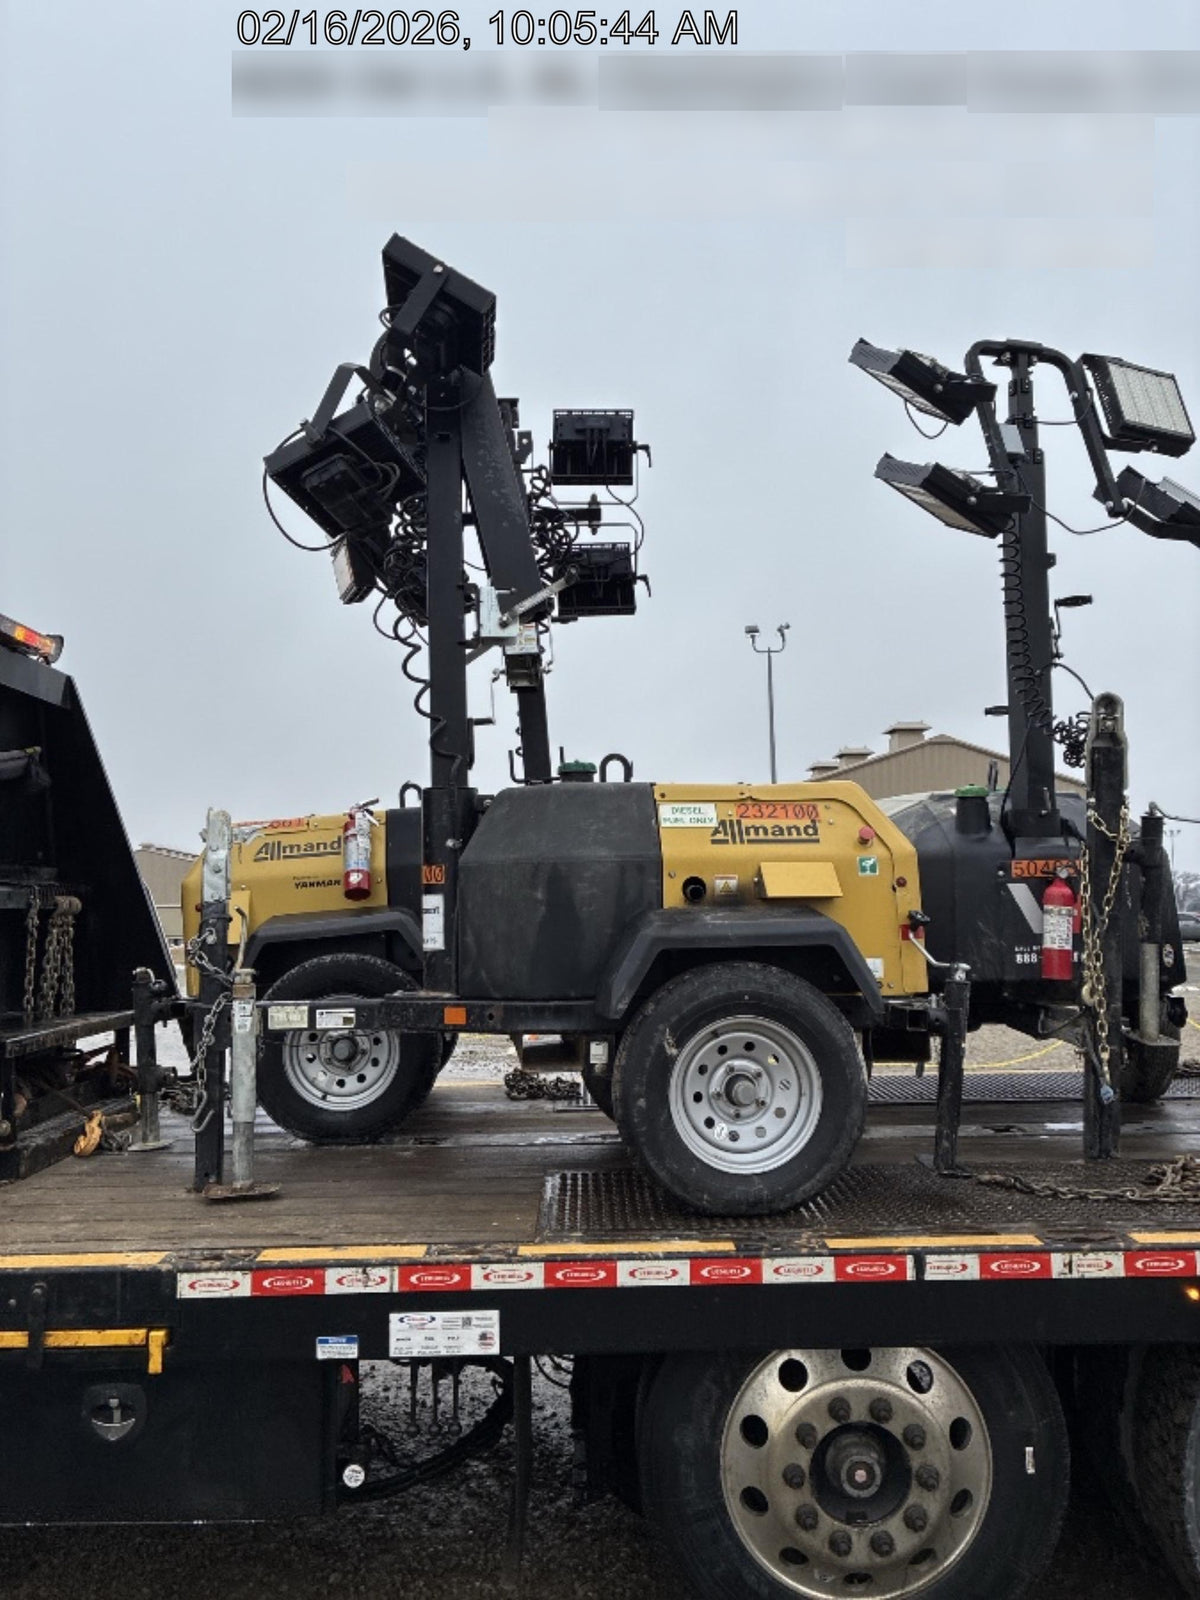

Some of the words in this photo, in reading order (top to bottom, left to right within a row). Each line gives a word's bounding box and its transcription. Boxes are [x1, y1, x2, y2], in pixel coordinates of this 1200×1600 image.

[736, 803, 819, 819] 232100
[711, 819, 819, 844] Allmand
[254, 835, 342, 862] Allmand
